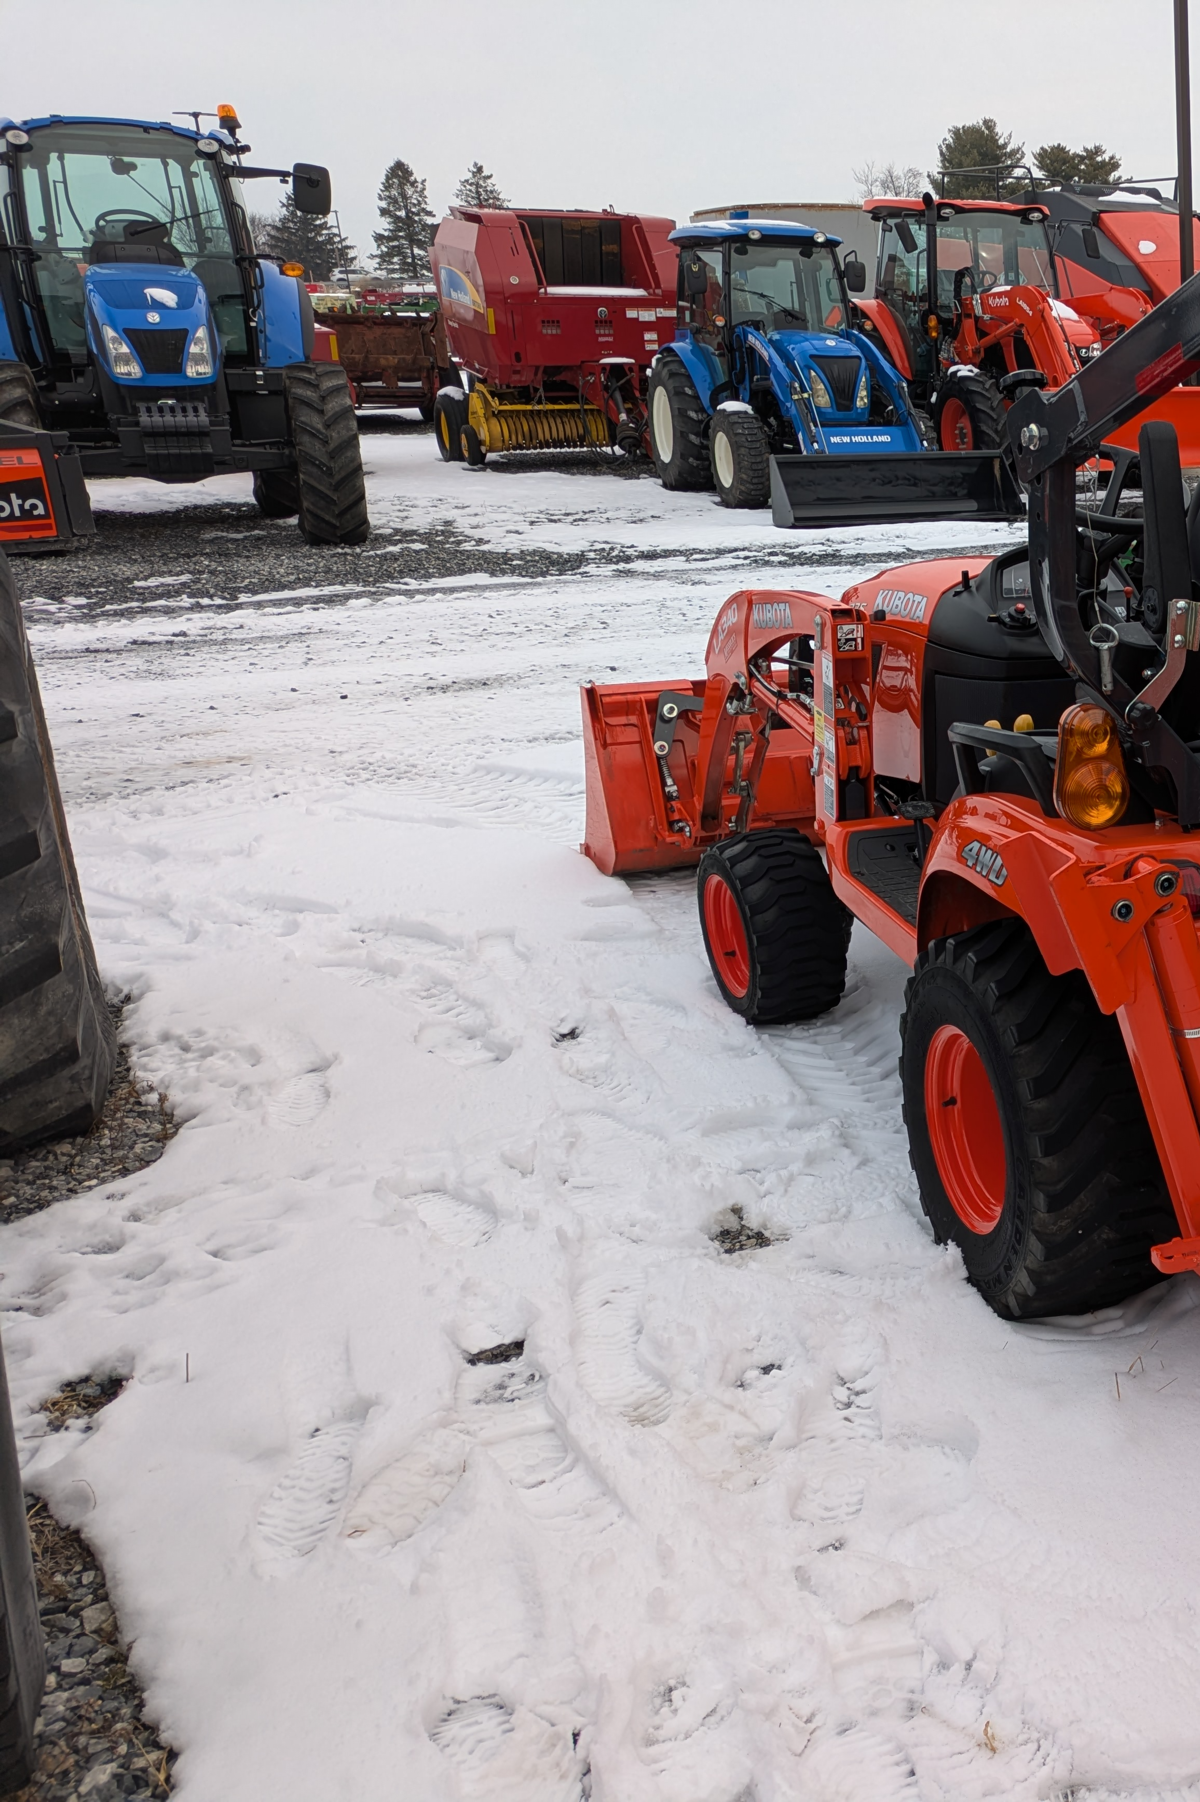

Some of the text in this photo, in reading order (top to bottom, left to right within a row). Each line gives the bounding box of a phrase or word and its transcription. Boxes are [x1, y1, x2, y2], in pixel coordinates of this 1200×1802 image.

[988, 295, 1009, 307] Kubota
[830, 435, 891, 444] NEW HOLLAND
[753, 601, 794, 630] KUBOTA
[873, 589, 928, 623] KUBOTA
[712, 603, 738, 655] LA340
[961, 839, 1008, 887] 4WD
[1003, 1156, 1026, 1278] GARDEN
